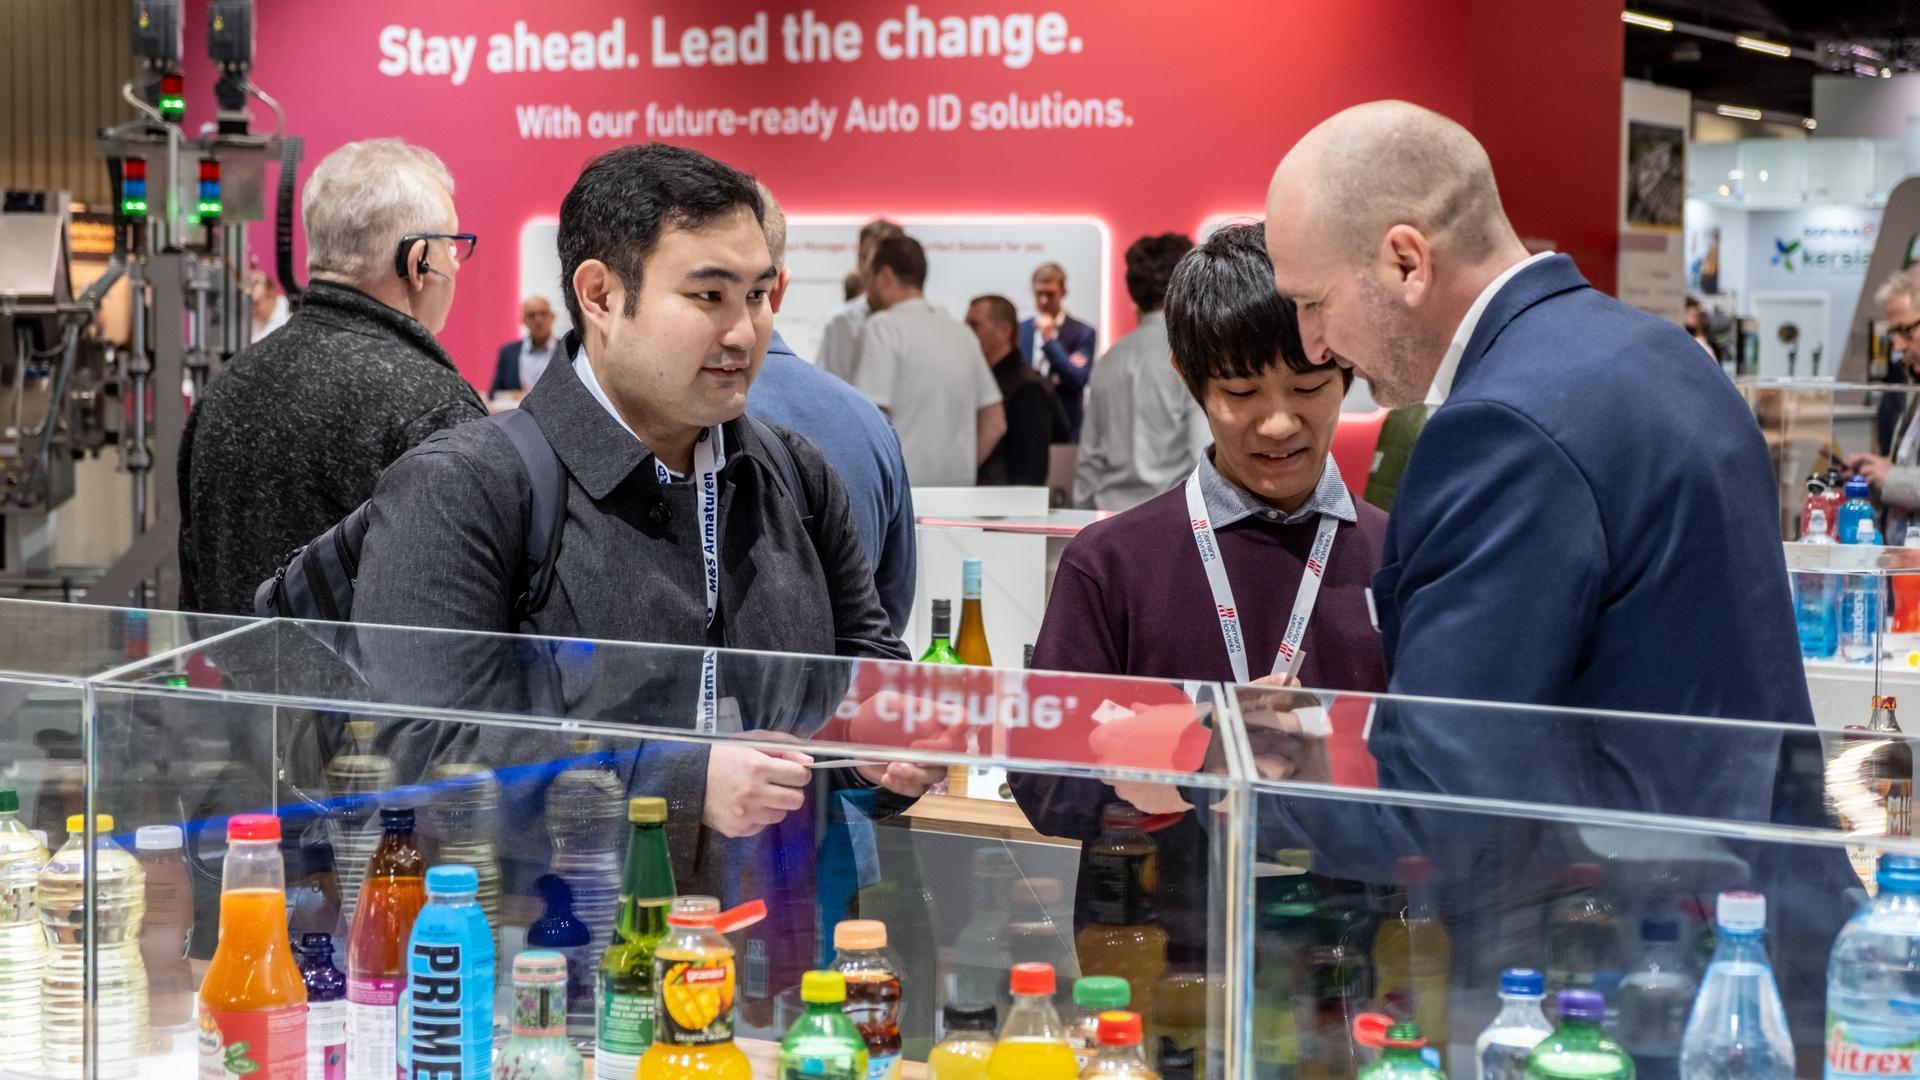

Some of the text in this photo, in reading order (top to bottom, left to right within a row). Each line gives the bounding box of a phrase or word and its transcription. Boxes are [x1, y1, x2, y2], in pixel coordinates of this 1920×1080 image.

[378, 5, 1084, 86] Stay ahead. Lead the change.
[515, 91, 1134, 140] With our future-ready Auto ID solutions.
[703, 471, 717, 593] M&S Armaturen
[1202, 529, 1216, 560] Ziemann
[1311, 531, 1326, 560] Ziemann
[1229, 618, 1241, 652] Ziemann
[1284, 614, 1297, 644] Ziemann
[411, 943, 462, 1080] PRIME
